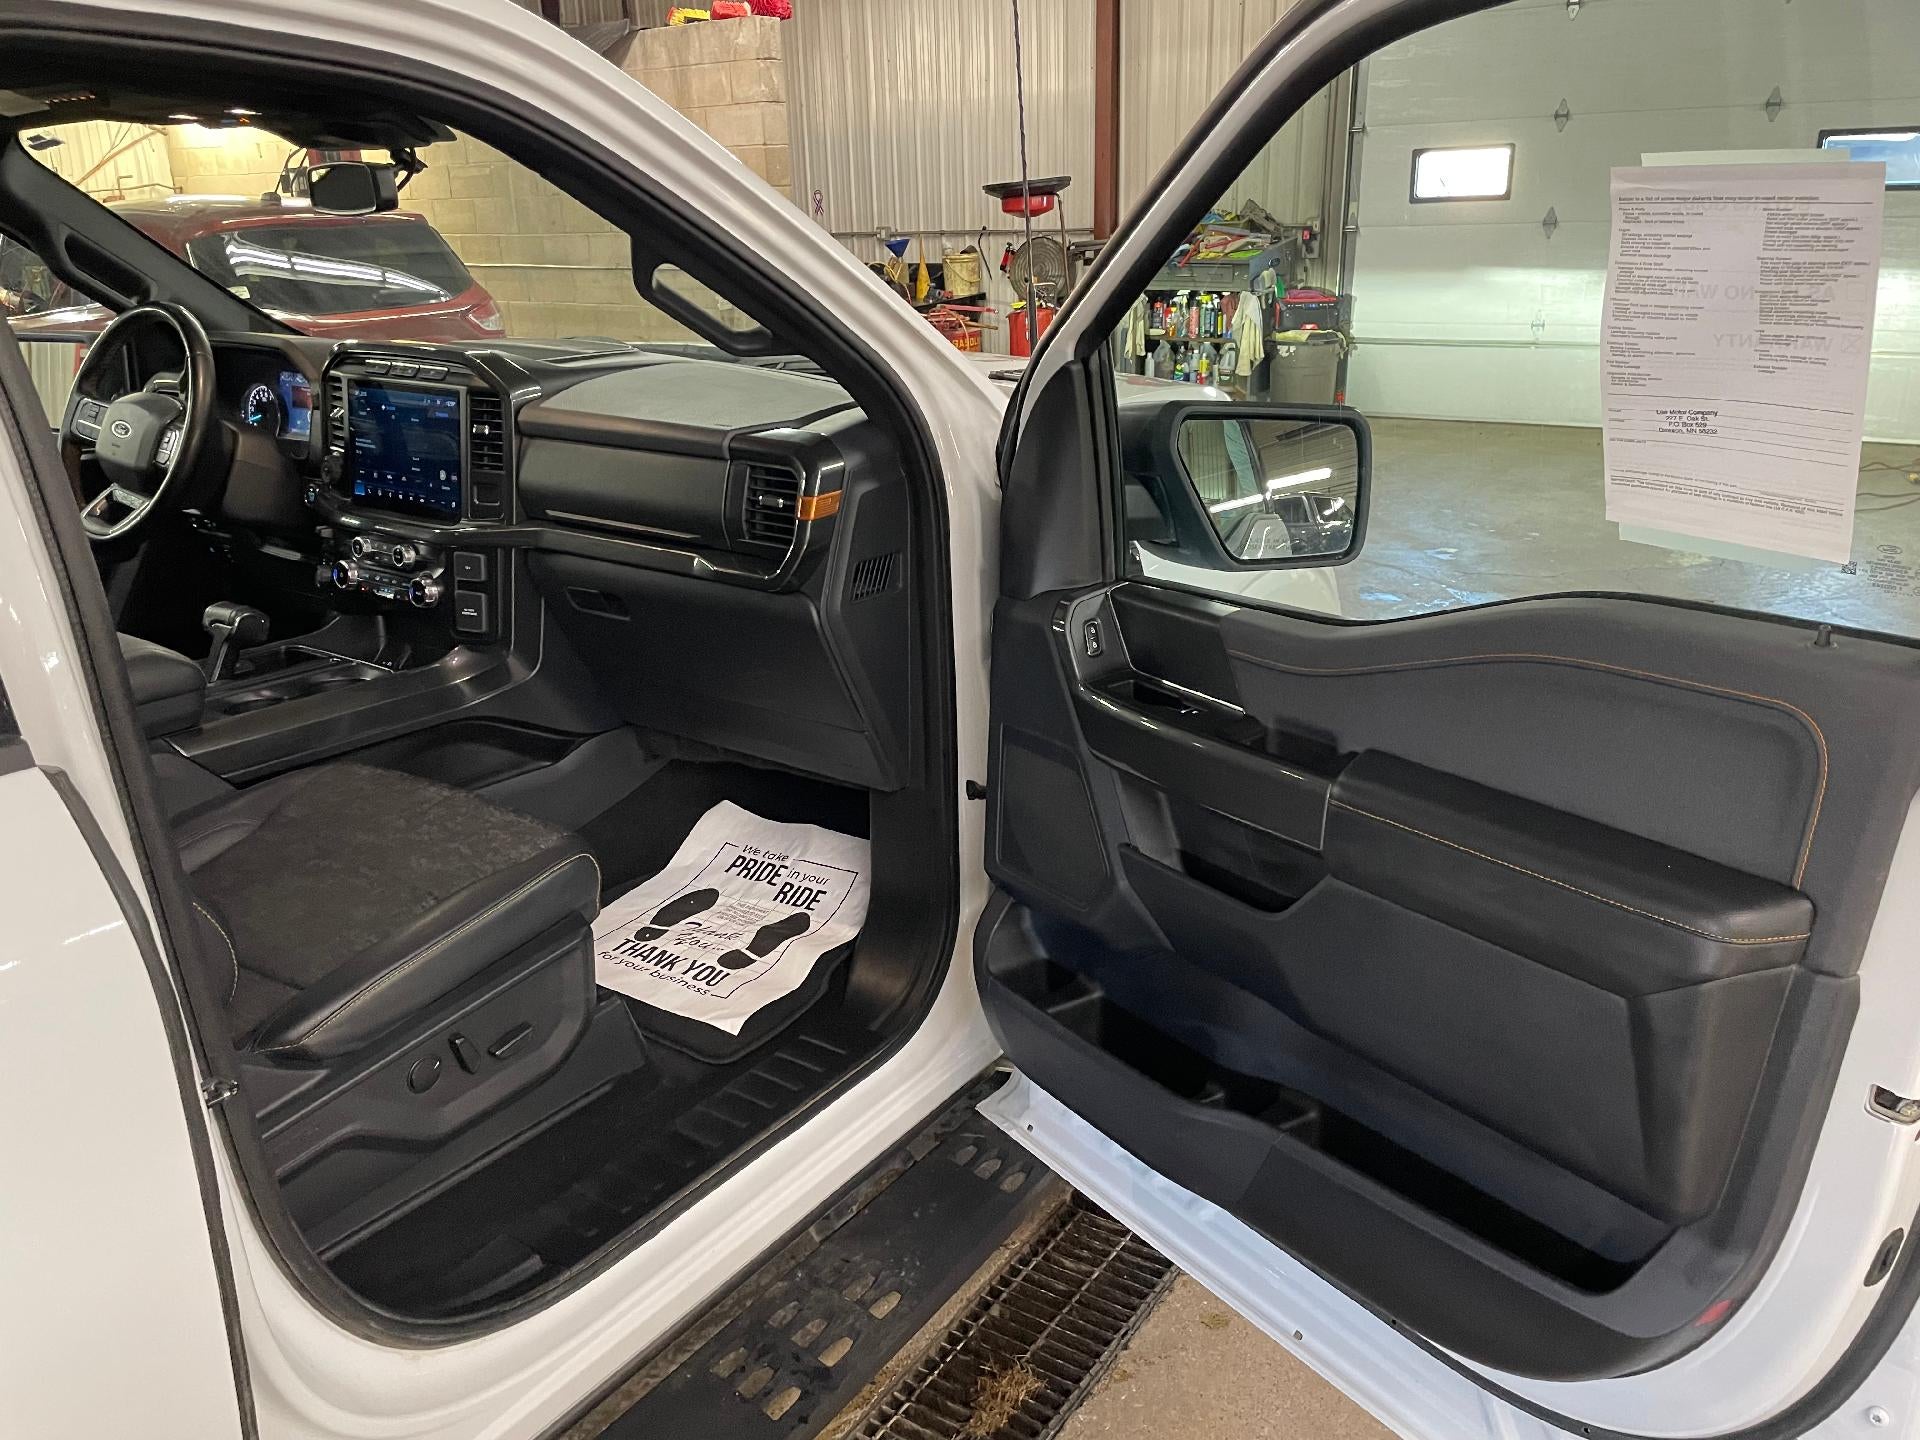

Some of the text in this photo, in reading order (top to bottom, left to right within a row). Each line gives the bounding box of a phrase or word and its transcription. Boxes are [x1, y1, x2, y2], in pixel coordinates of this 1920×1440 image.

[743, 844, 789, 861] We take
[724, 854, 831, 887] PRIDE in your
[772, 881, 828, 912] RIDE
[597, 951, 711, 996] for your business
[612, 938, 731, 987] THANK YOU
